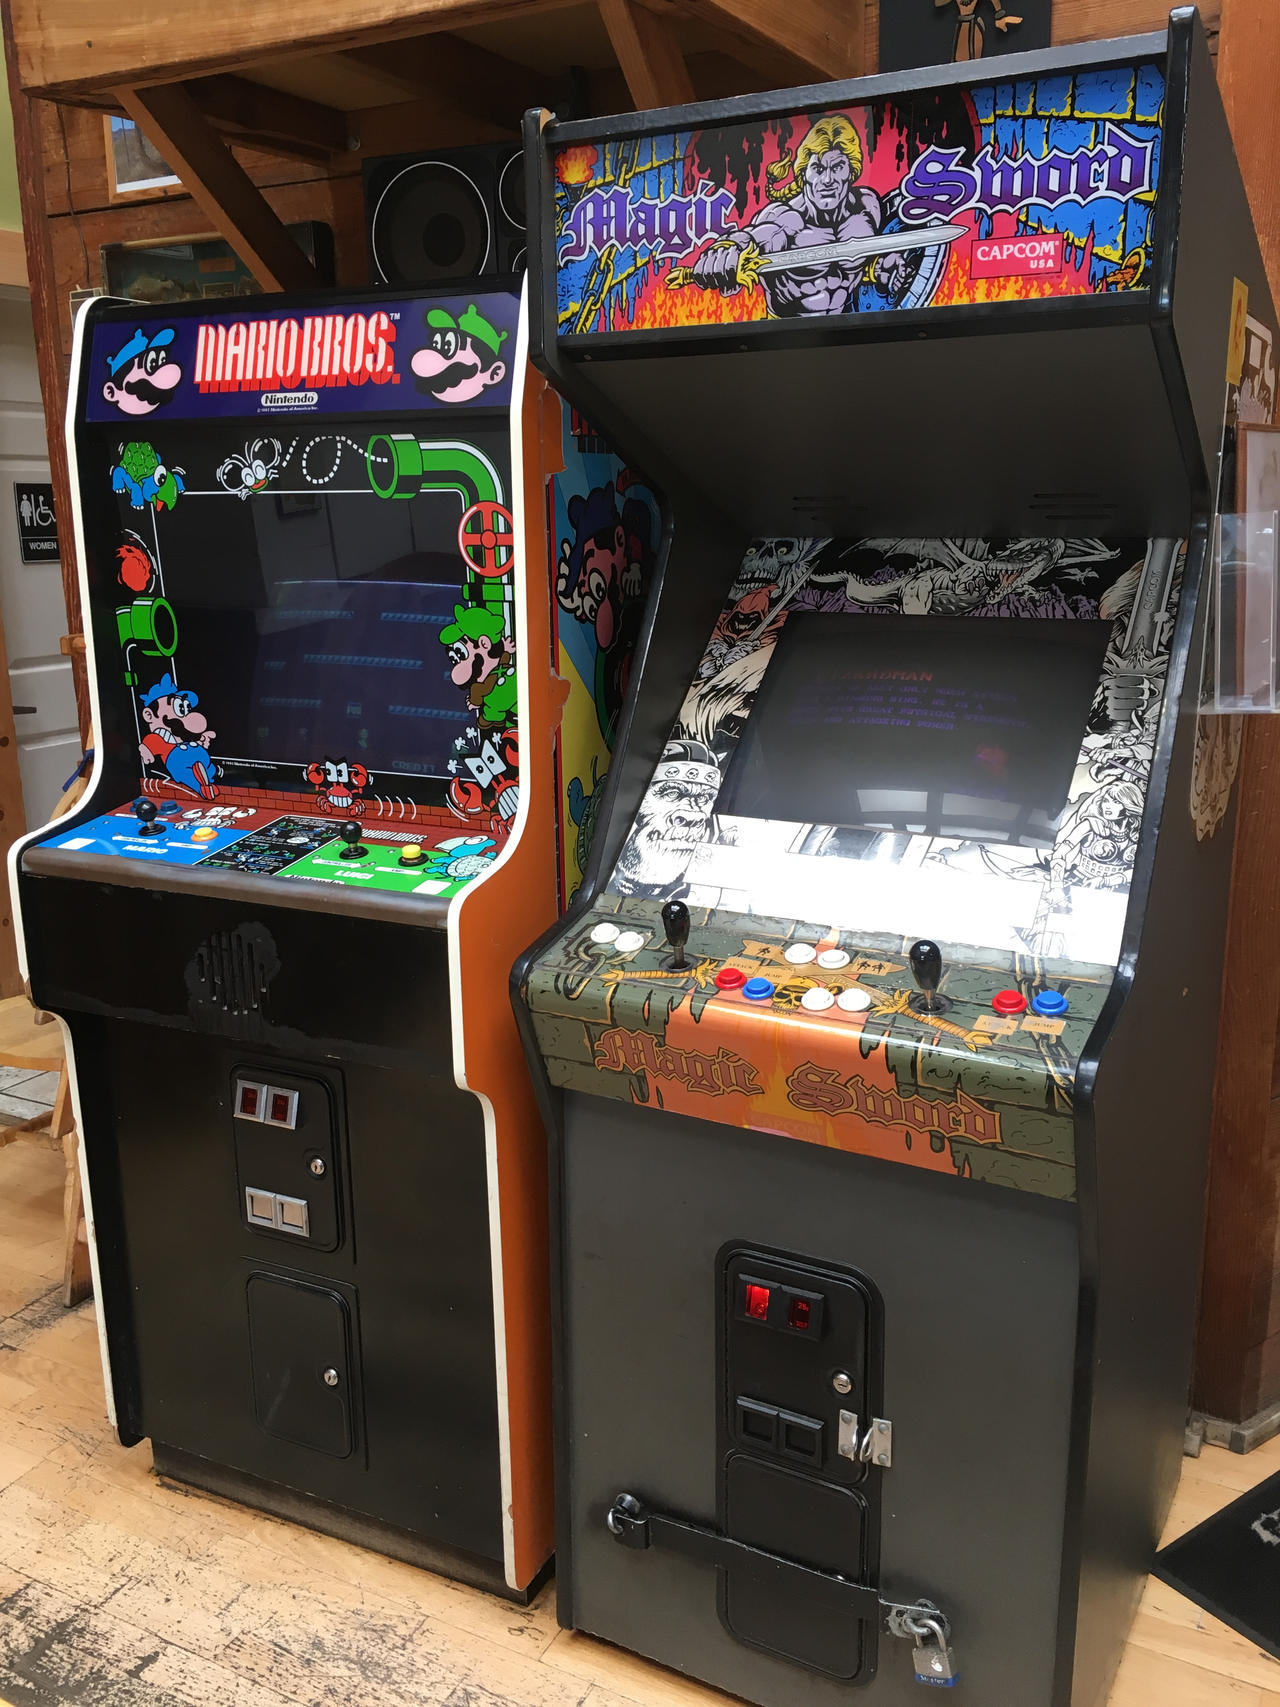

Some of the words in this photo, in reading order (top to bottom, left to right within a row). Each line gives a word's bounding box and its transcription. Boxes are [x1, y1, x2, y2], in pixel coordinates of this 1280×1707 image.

[559, 178, 740, 268] Magic
[899, 121, 1154, 225] Sword
[1029, 258, 1054, 269] USA
[194, 317, 302, 392] MARIO
[264, 392, 316, 405] Nintendo
[29, 541, 57, 550] WOMEN
[122, 845, 169, 855] MARIO
[334, 870, 375, 880] LUIGI
[593, 1026, 766, 1097] Magic
[786, 1061, 1004, 1145] Sword
